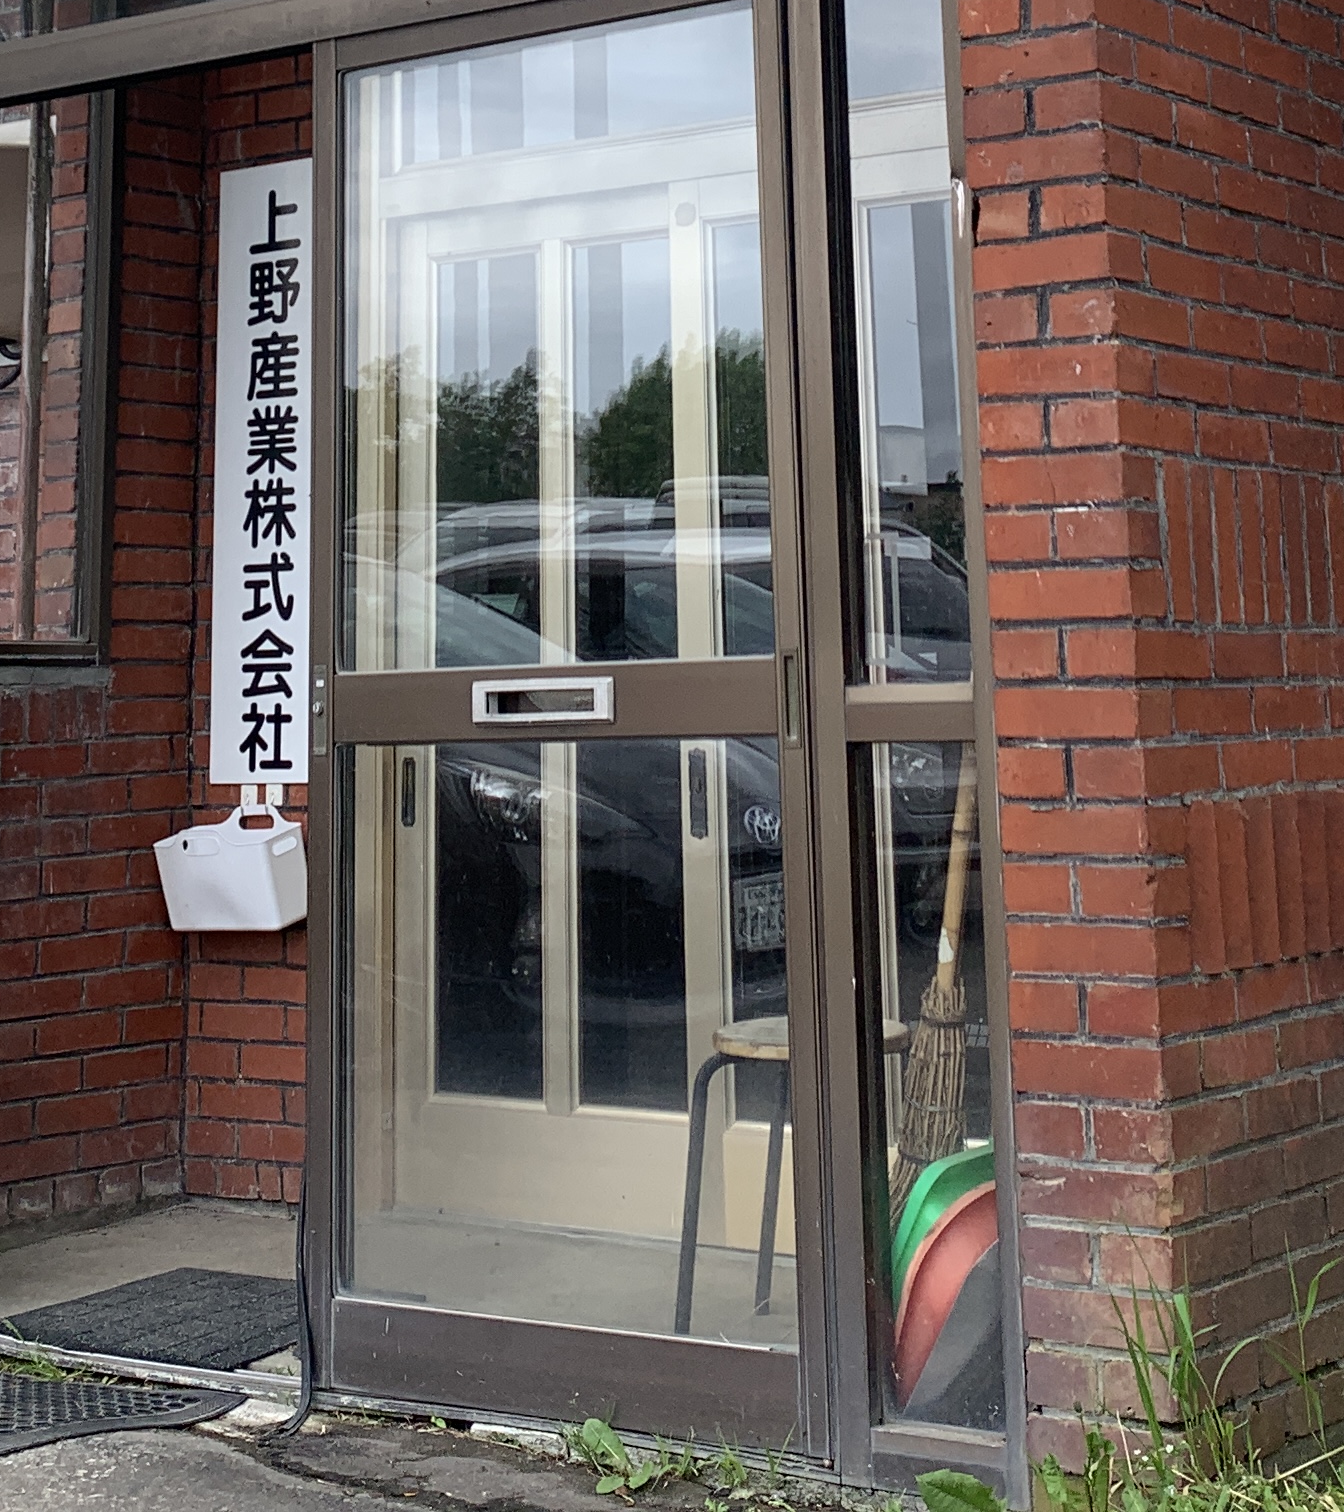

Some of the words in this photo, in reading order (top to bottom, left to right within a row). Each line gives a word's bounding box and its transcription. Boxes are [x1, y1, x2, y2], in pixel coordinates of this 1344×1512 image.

[239, 190, 301, 774] 上野産業株式会社
